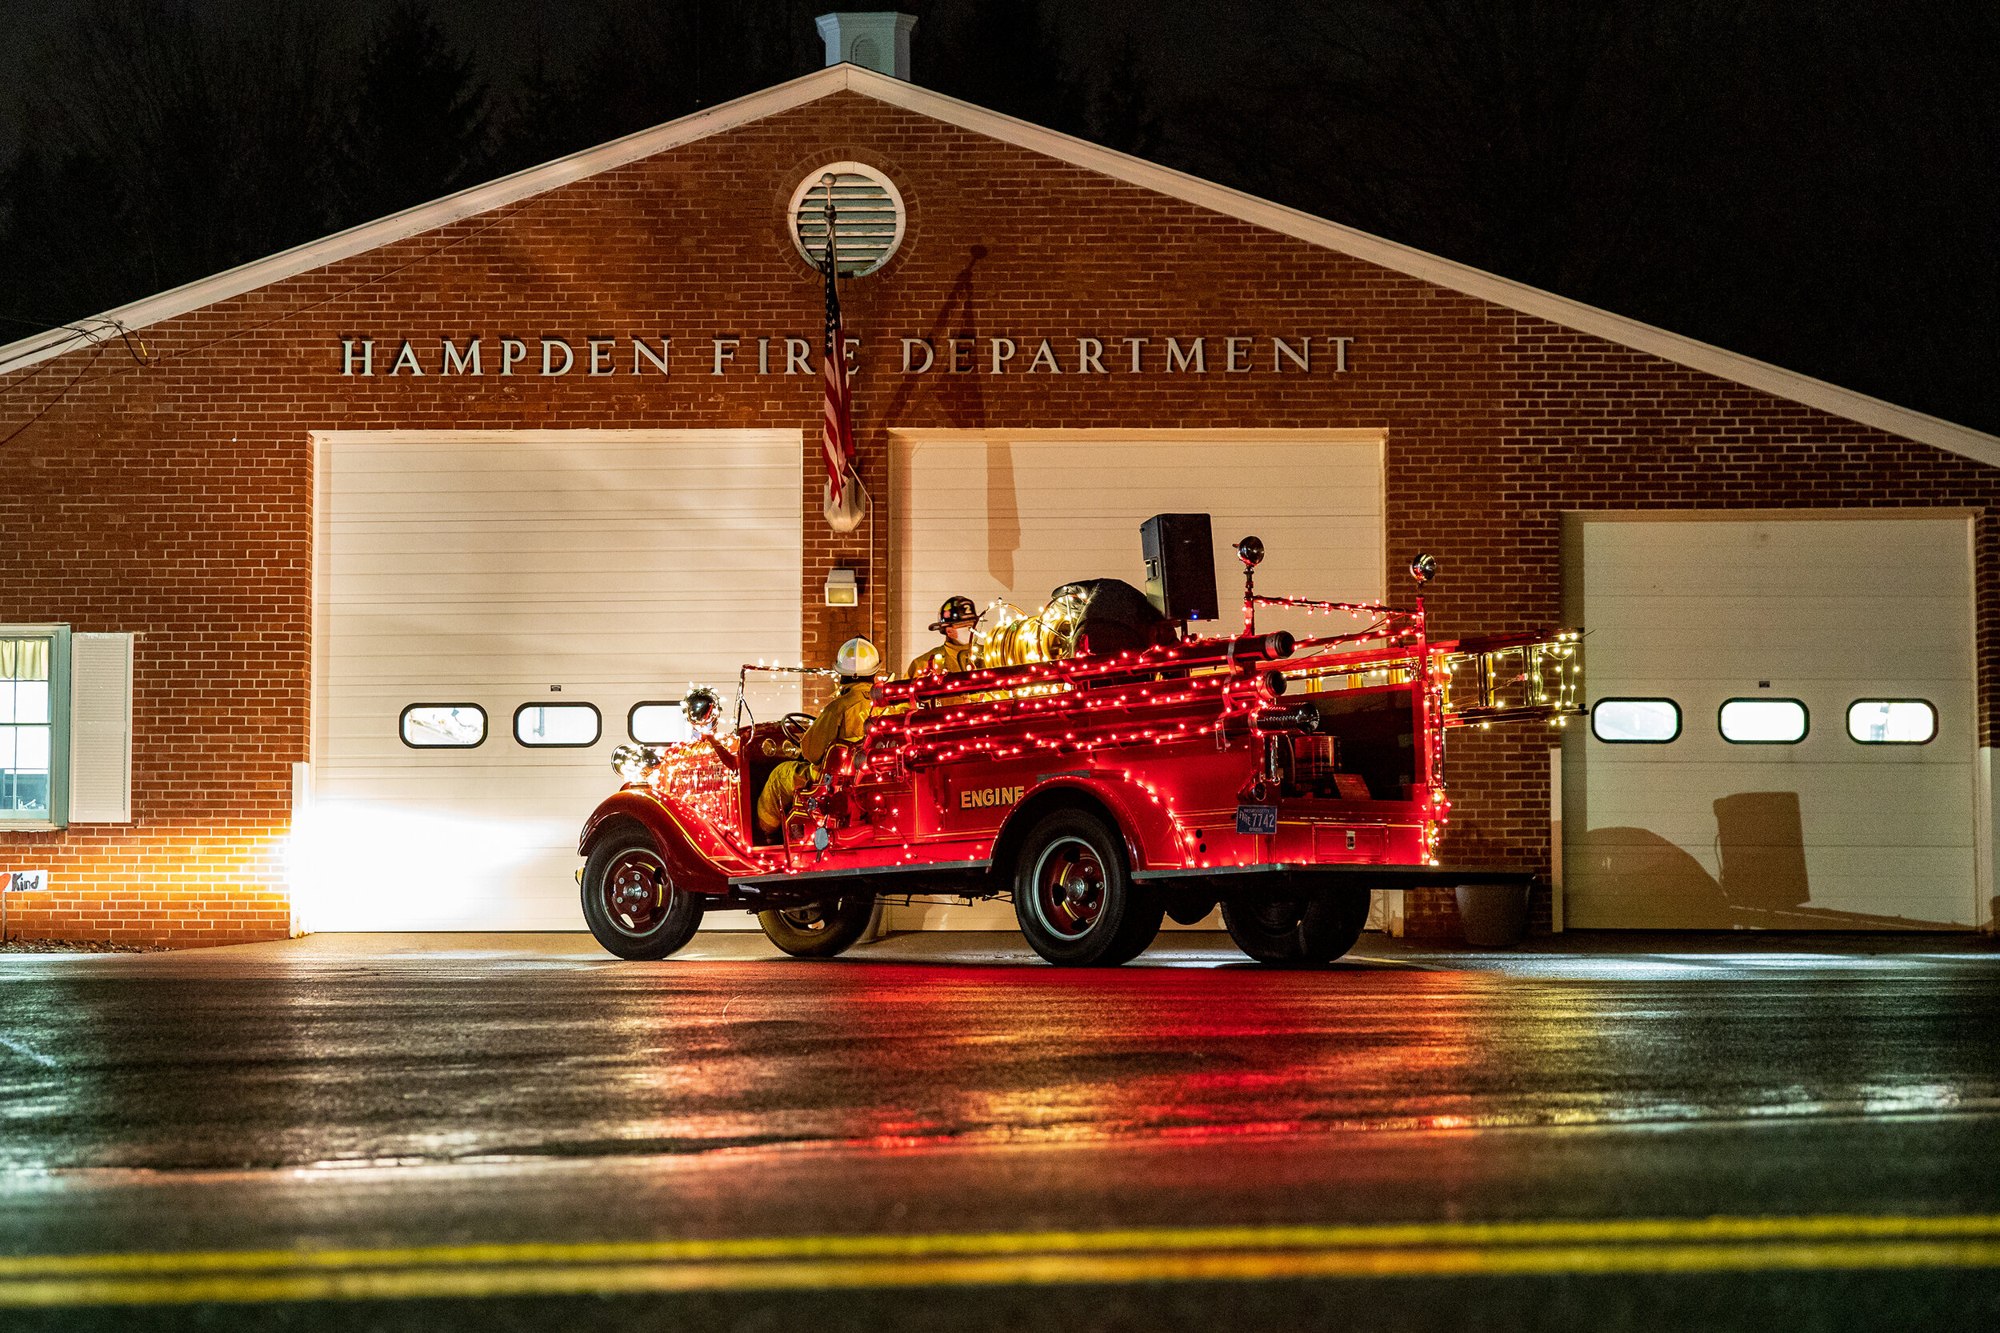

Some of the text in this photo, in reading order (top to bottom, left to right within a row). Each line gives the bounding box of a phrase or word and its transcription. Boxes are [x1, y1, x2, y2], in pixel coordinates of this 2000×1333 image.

[341, 338, 672, 377] HAMPDEN
[899, 336, 1355, 375] DEPARTMENT
[963, 604, 972, 613] 2
[1252, 813, 1274, 828] 7742
[12, 872, 39, 891] Kind
